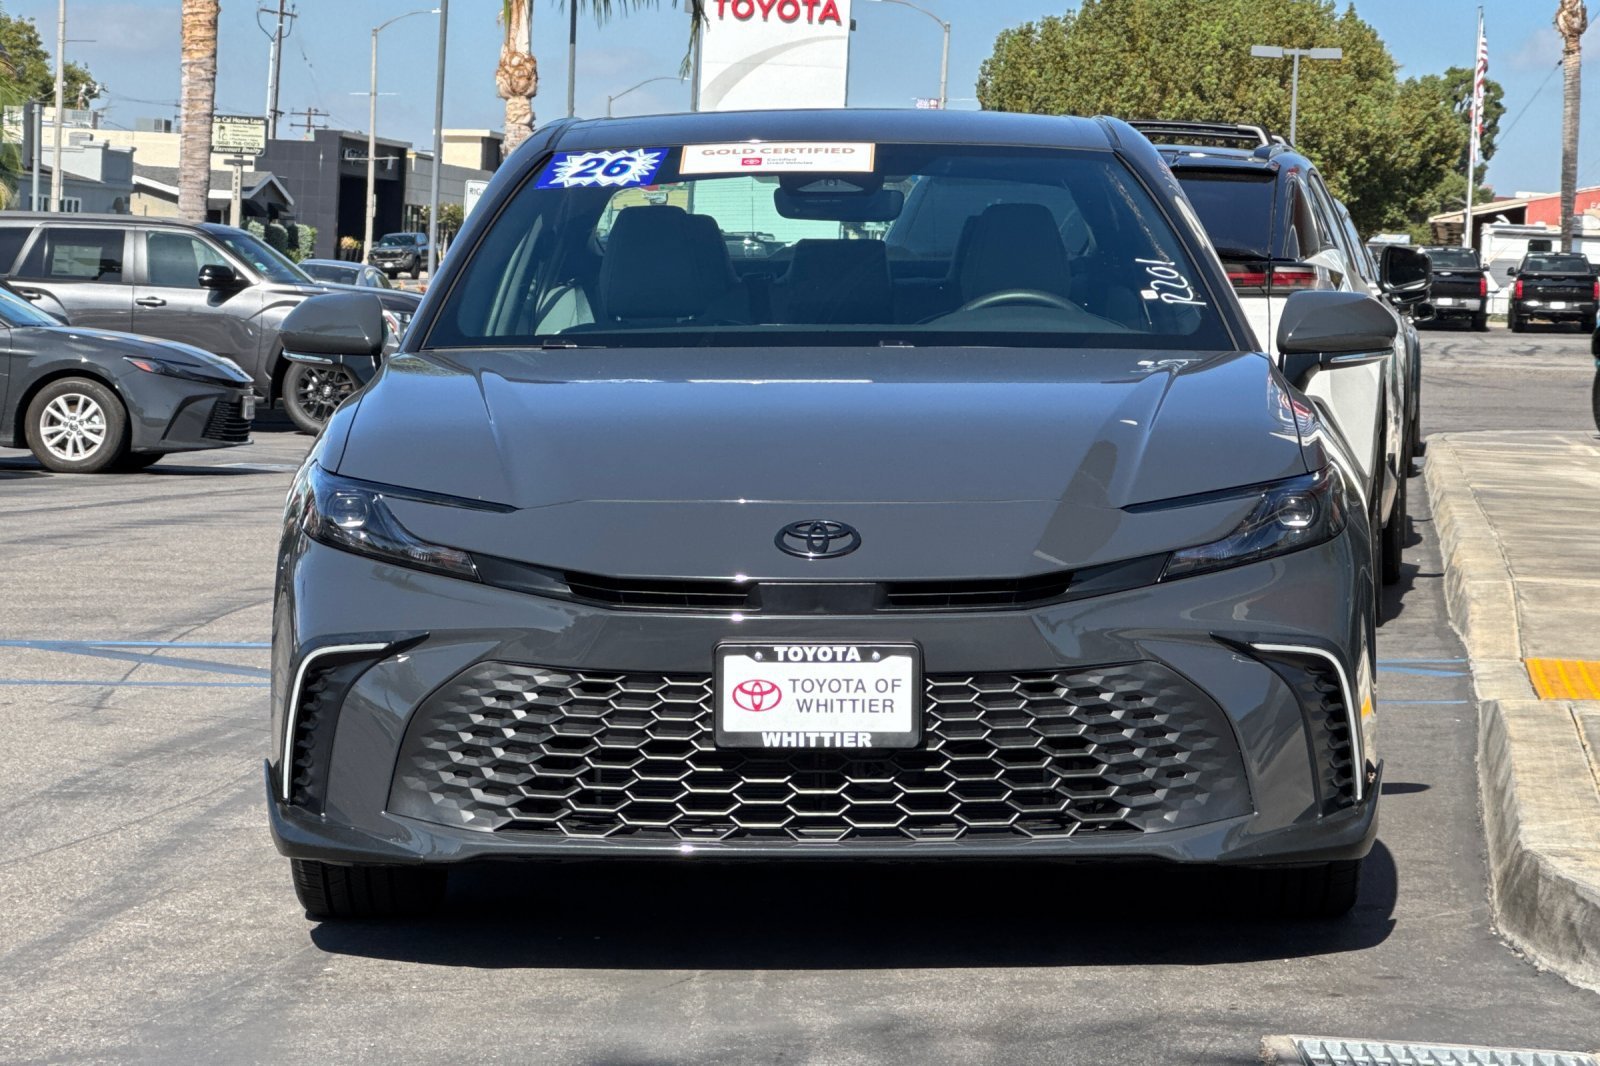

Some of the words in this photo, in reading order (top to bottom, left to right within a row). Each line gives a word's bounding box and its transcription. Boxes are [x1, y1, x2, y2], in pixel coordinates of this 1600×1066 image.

[714, 0, 843, 25] TOYOTA
[232, 116, 249, 124] Home
[250, 117, 265, 125] Loan
[702, 148, 756, 156] GOLD
[760, 147, 856, 155] CERTIFIED
[569, 156, 637, 178] 26
[774, 646, 862, 662] TOYOTA
[788, 678, 867, 694] TOYOTA
[874, 678, 903, 694] OF
[796, 698, 896, 714] WHITTIER
[761, 731, 872, 748] WHITTIER
